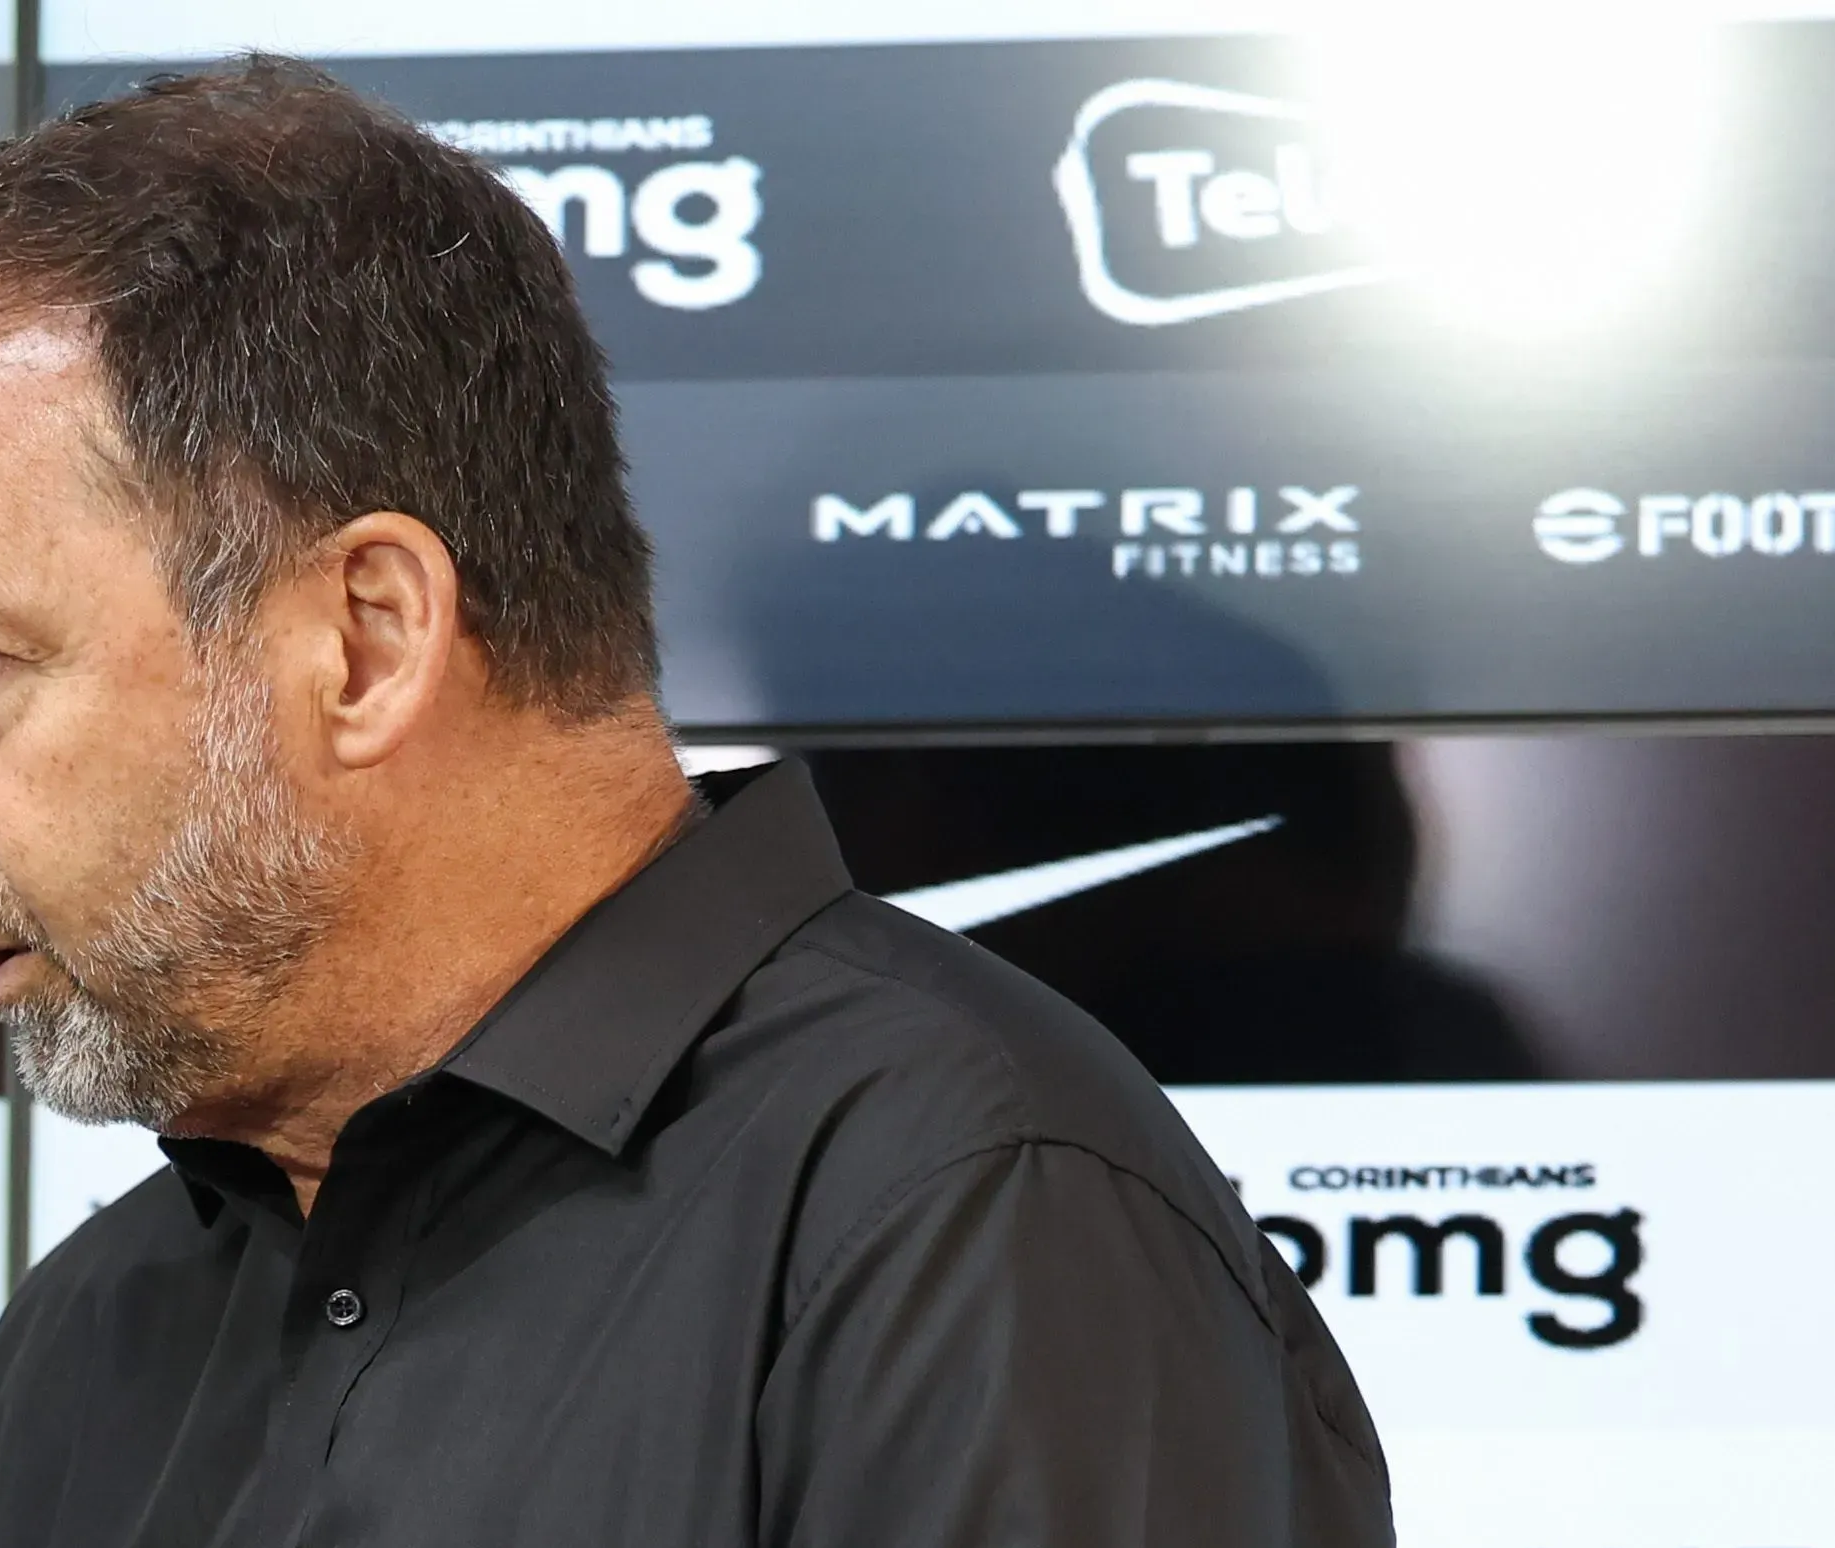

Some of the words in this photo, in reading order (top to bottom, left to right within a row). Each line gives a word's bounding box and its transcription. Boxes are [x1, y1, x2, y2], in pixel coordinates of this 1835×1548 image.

[502, 156, 761, 310] mg
[811, 486, 1361, 542] MATRIX
[1113, 541, 1360, 578] FITNESS
[1289, 1164, 1597, 1190] CORINTHIANS
